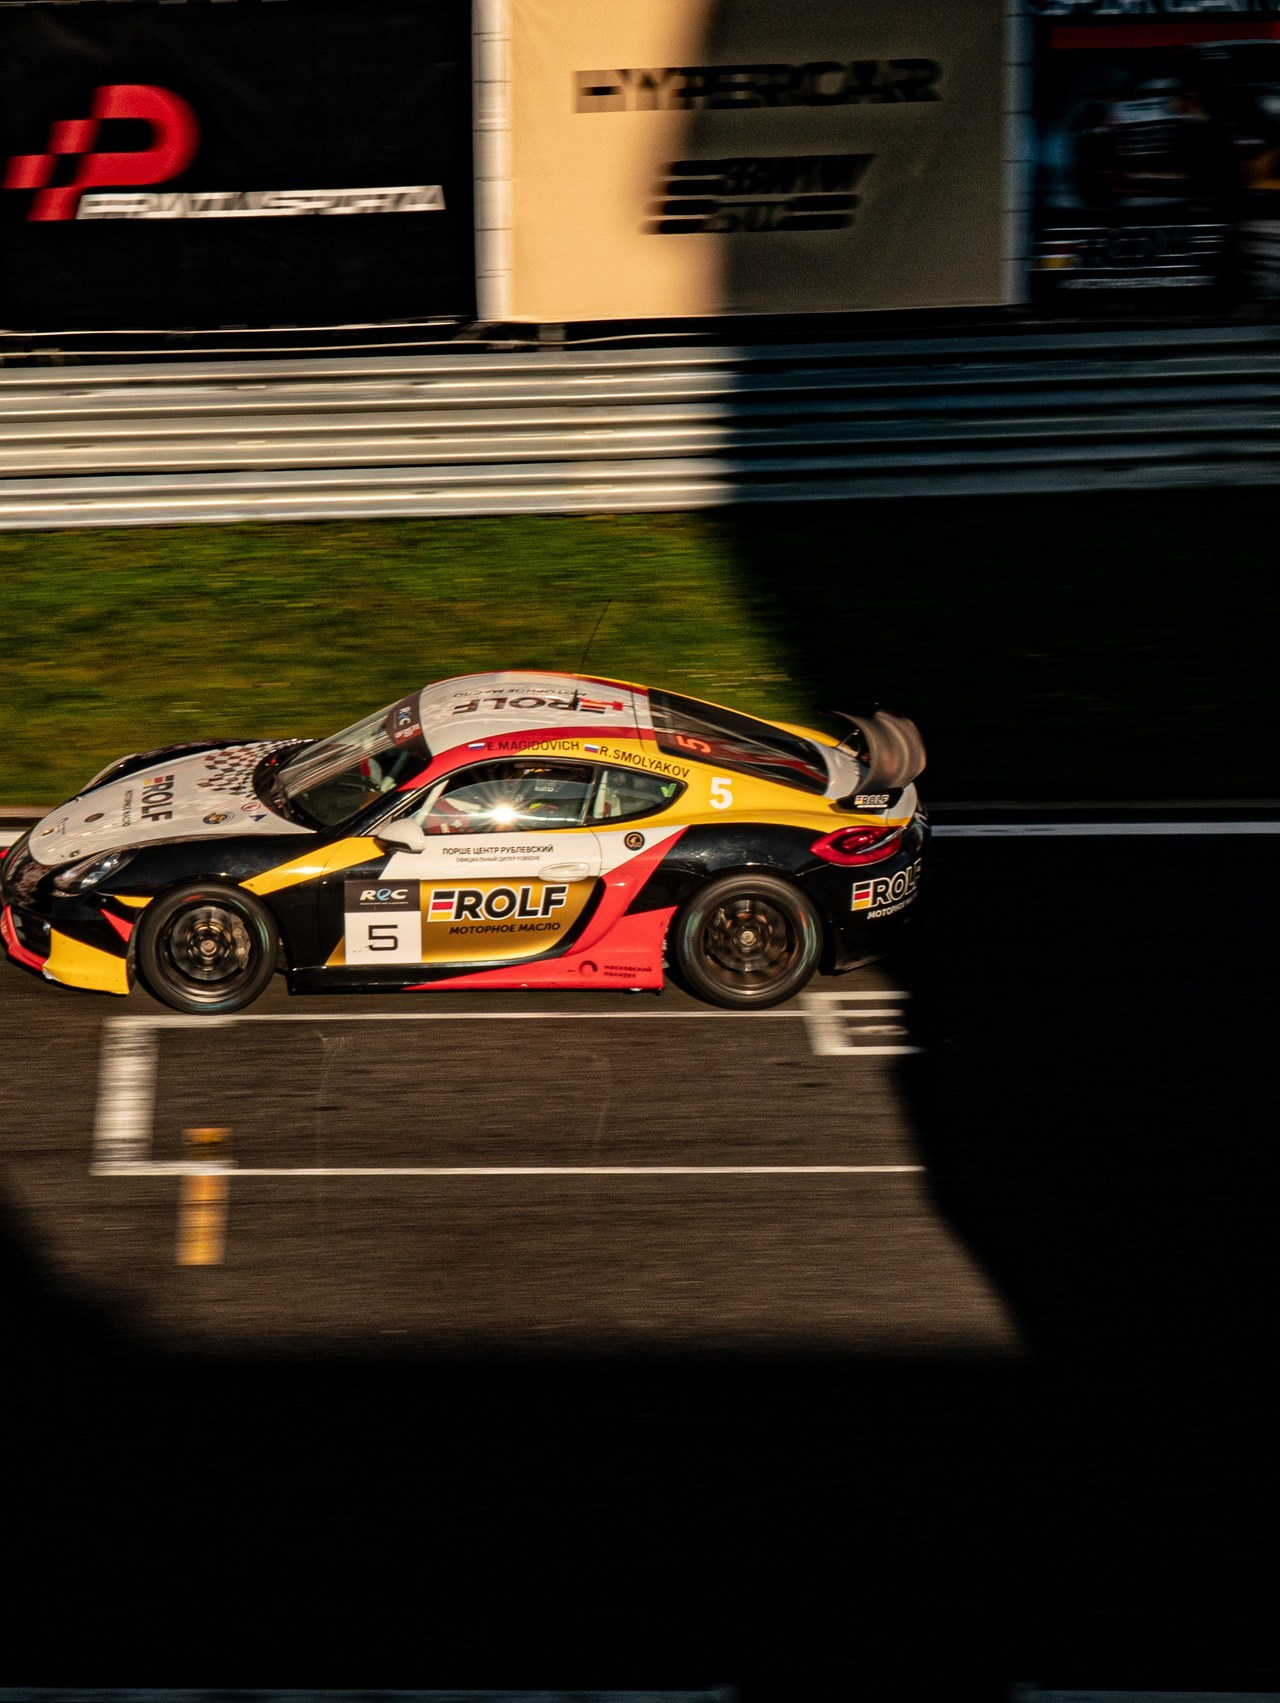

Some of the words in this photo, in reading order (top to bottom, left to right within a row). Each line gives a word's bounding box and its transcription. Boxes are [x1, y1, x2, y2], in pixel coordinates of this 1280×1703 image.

[451, 696, 579, 716] ROLF
[675, 735, 712, 754] 5
[599, 745, 690, 779] R.SMOLYAKOV
[141, 782, 175, 822] ROLF
[708, 776, 734, 810] 5
[861, 795, 890, 805] ROLF
[442, 847, 471, 856] ПОРШЕ
[472, 847, 500, 856] ЦЕНТР
[500, 844, 554, 854] РУБЛЕВСКИЙ
[453, 884, 569, 921] ROLF
[368, 925, 398, 952] 5
[449, 924, 516, 935] МОТОРНОЕ
[518, 922, 561, 932] МАСЛО
